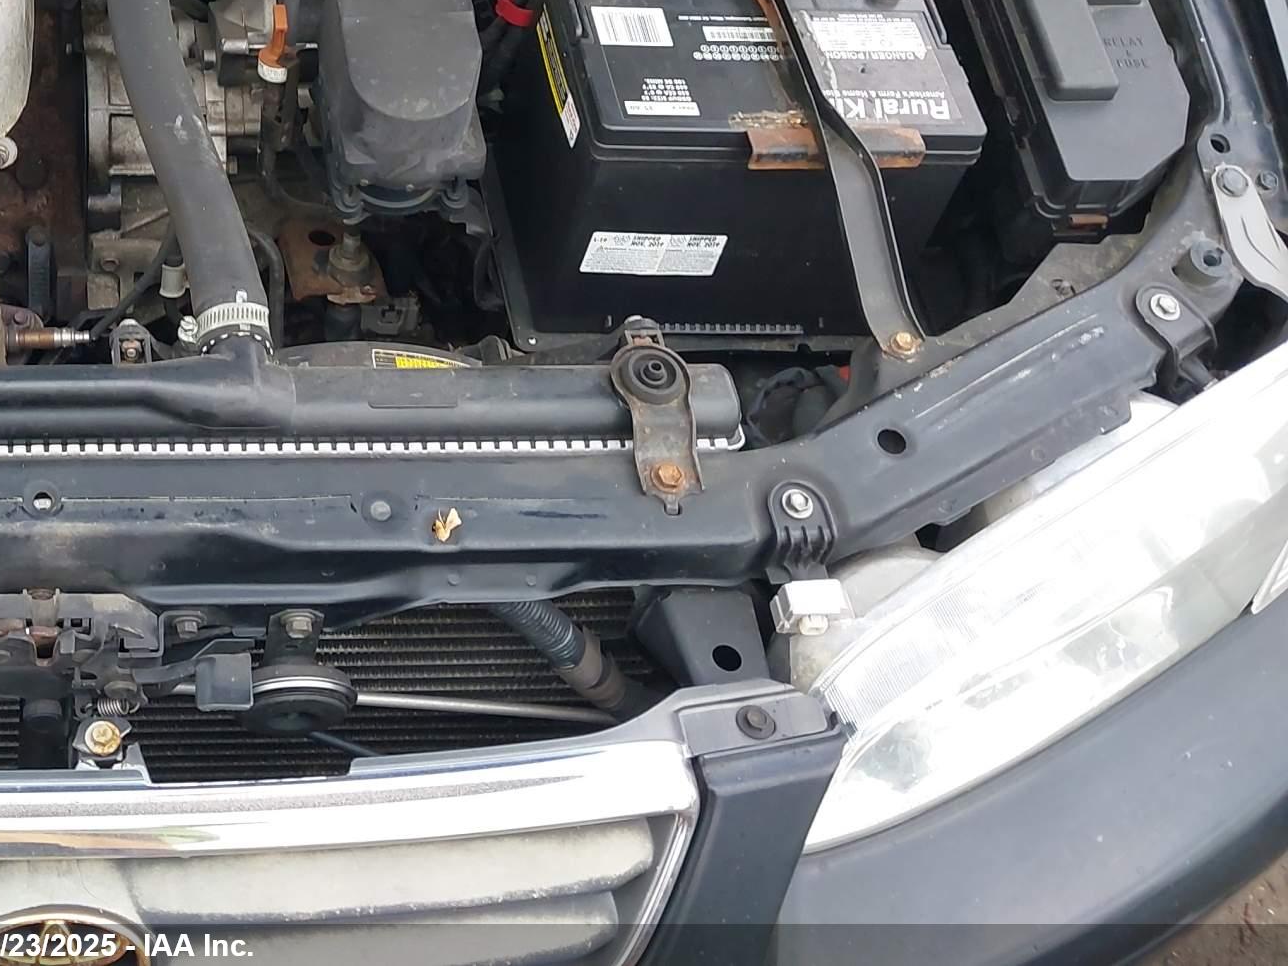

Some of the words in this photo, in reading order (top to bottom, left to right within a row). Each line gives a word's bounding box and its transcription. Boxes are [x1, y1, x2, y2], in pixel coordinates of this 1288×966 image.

[826, 50, 865, 60] POISON
[872, 50, 915, 60] DANGER
[842, 89, 868, 97] Home
[903, 90, 945, 99] America's
[875, 97, 951, 120] Rural
